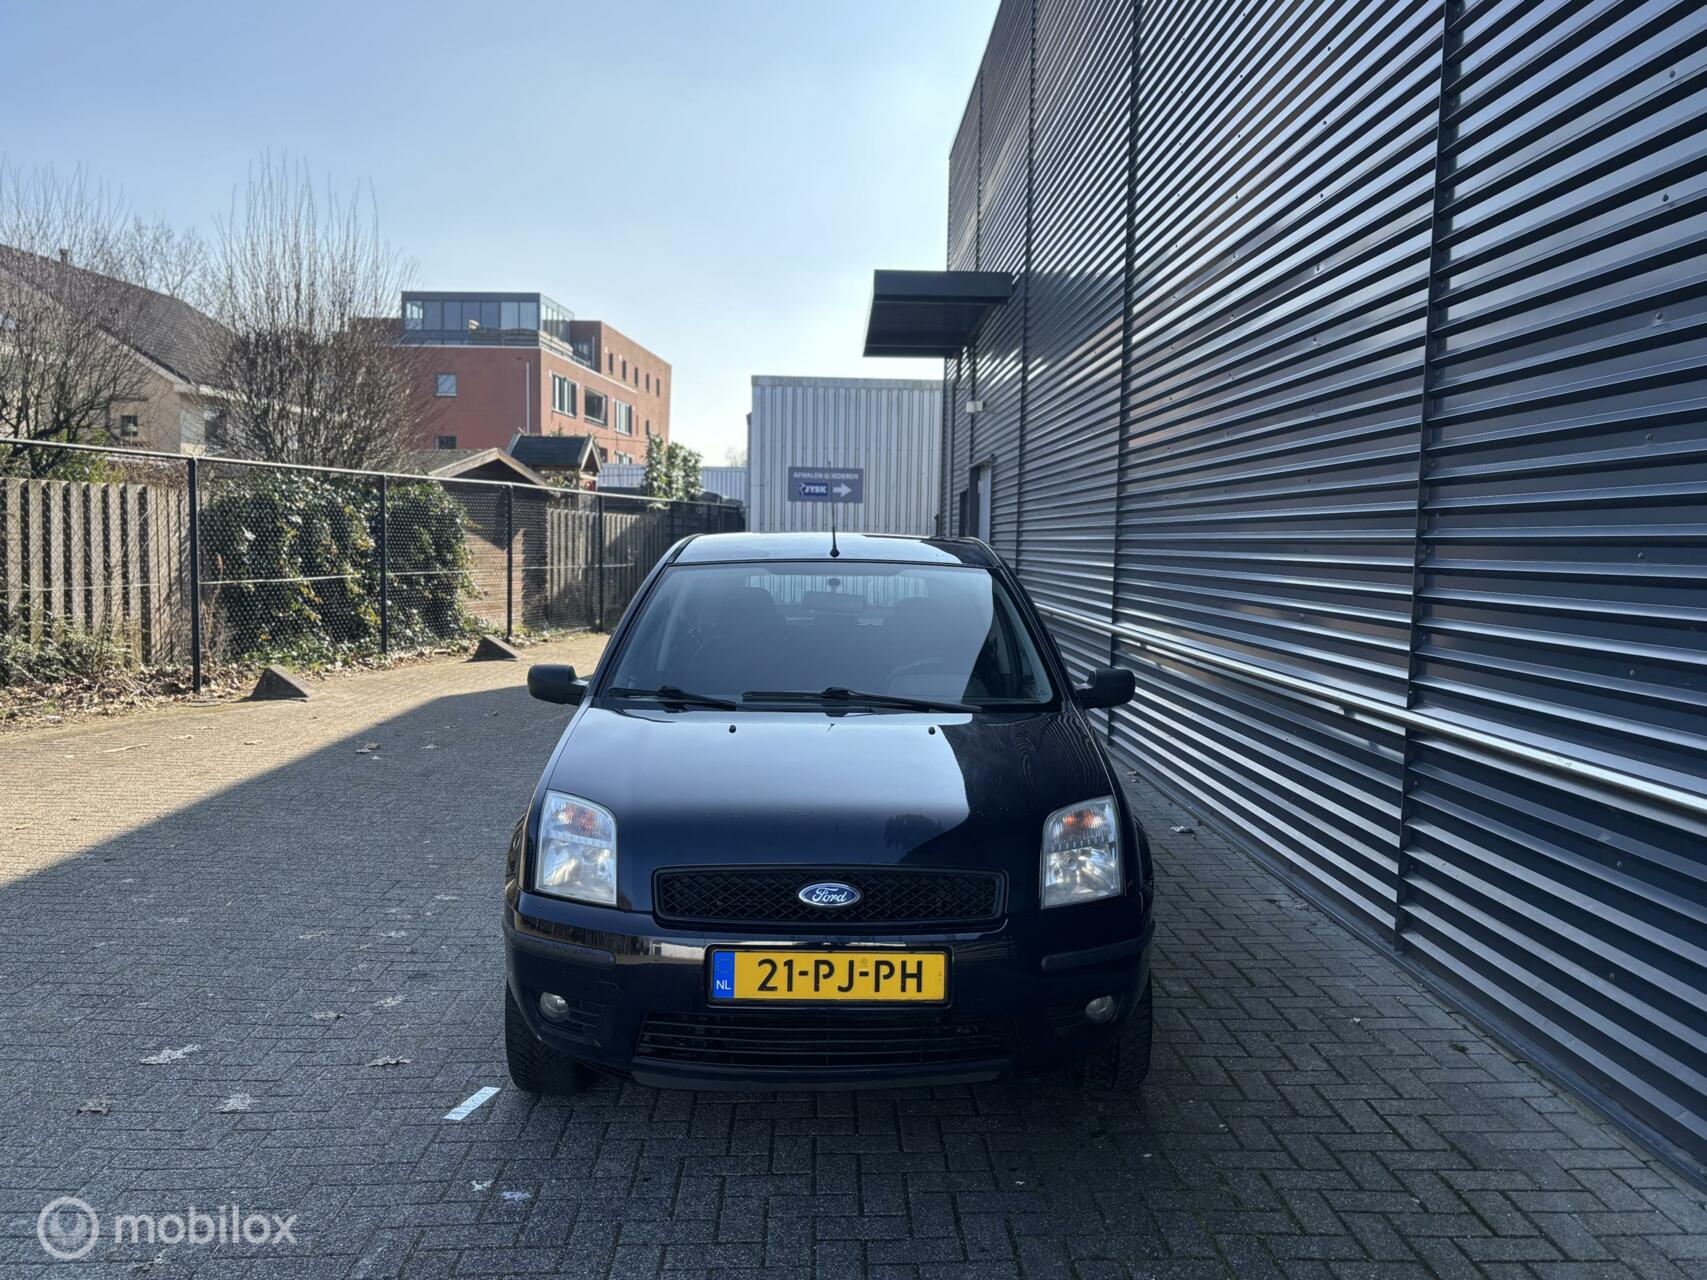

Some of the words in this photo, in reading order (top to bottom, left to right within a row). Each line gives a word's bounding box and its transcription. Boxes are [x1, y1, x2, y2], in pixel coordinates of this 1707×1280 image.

[812, 887, 847, 903] Ford
[757, 958, 923, 993] 21-PJ-PH
[716, 980, 731, 991] NL
